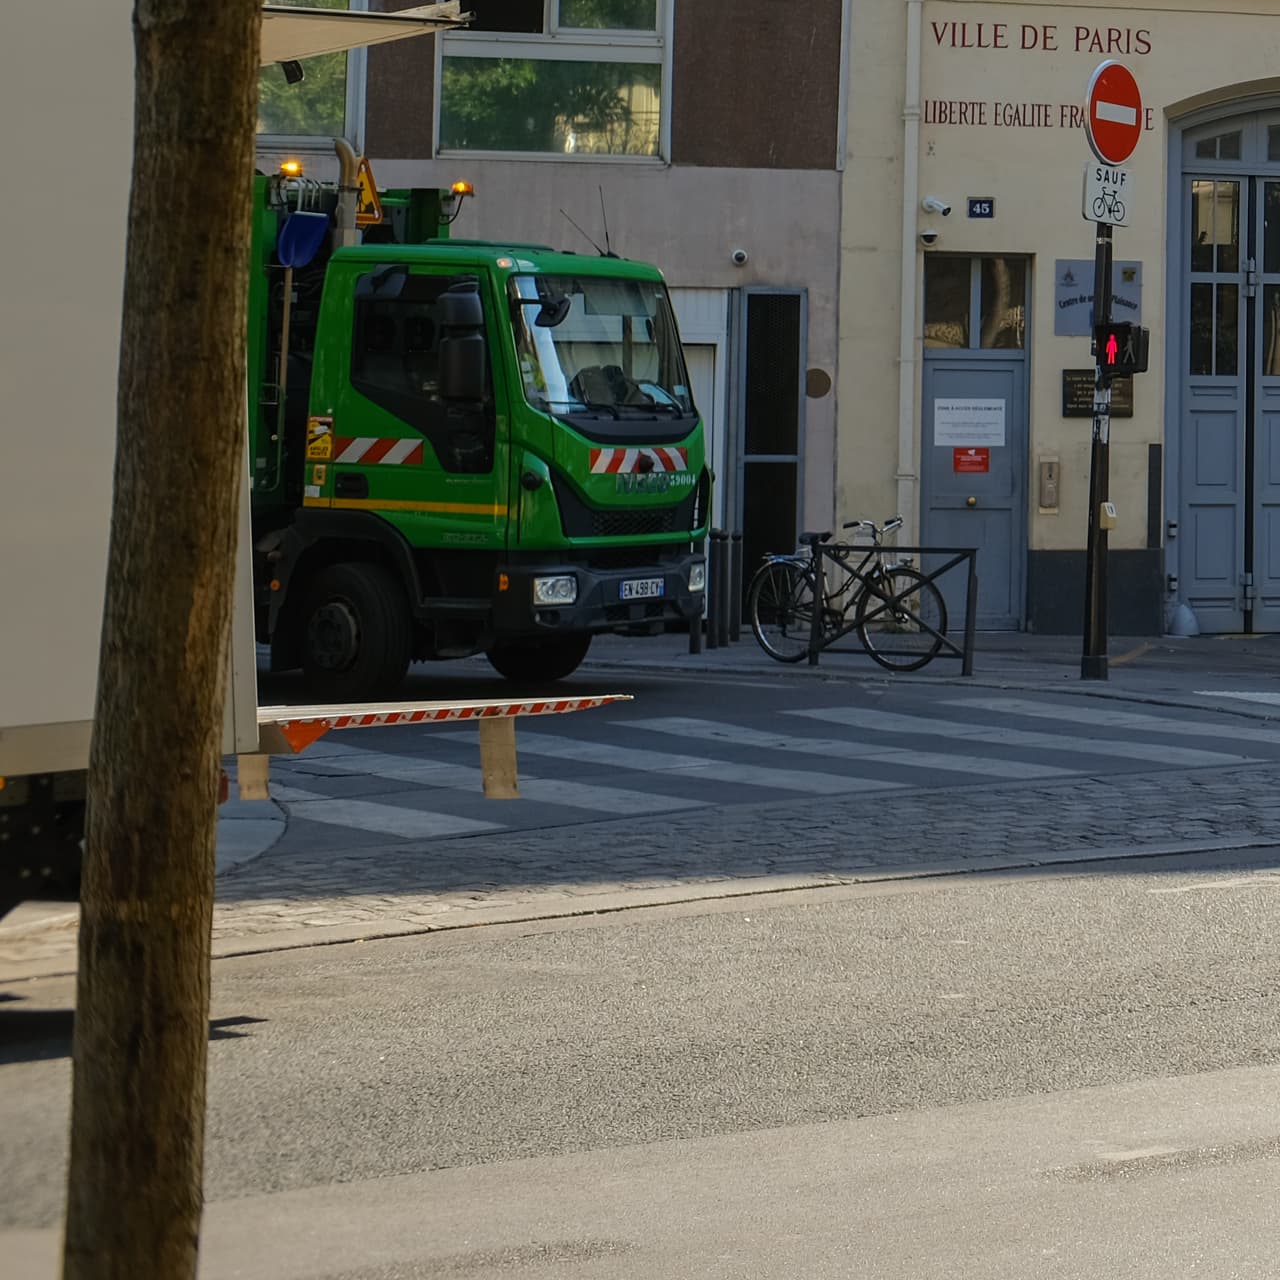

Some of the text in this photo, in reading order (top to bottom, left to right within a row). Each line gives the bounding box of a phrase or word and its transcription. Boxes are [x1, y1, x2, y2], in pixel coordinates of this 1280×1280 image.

[930, 21, 1152, 55] VILLE DE PARIS
[924, 100, 988, 126] LIBERTE
[994, 103, 1053, 128] EGALITE
[1096, 168, 1127, 186] SAUF
[972, 203, 990, 214] 45
